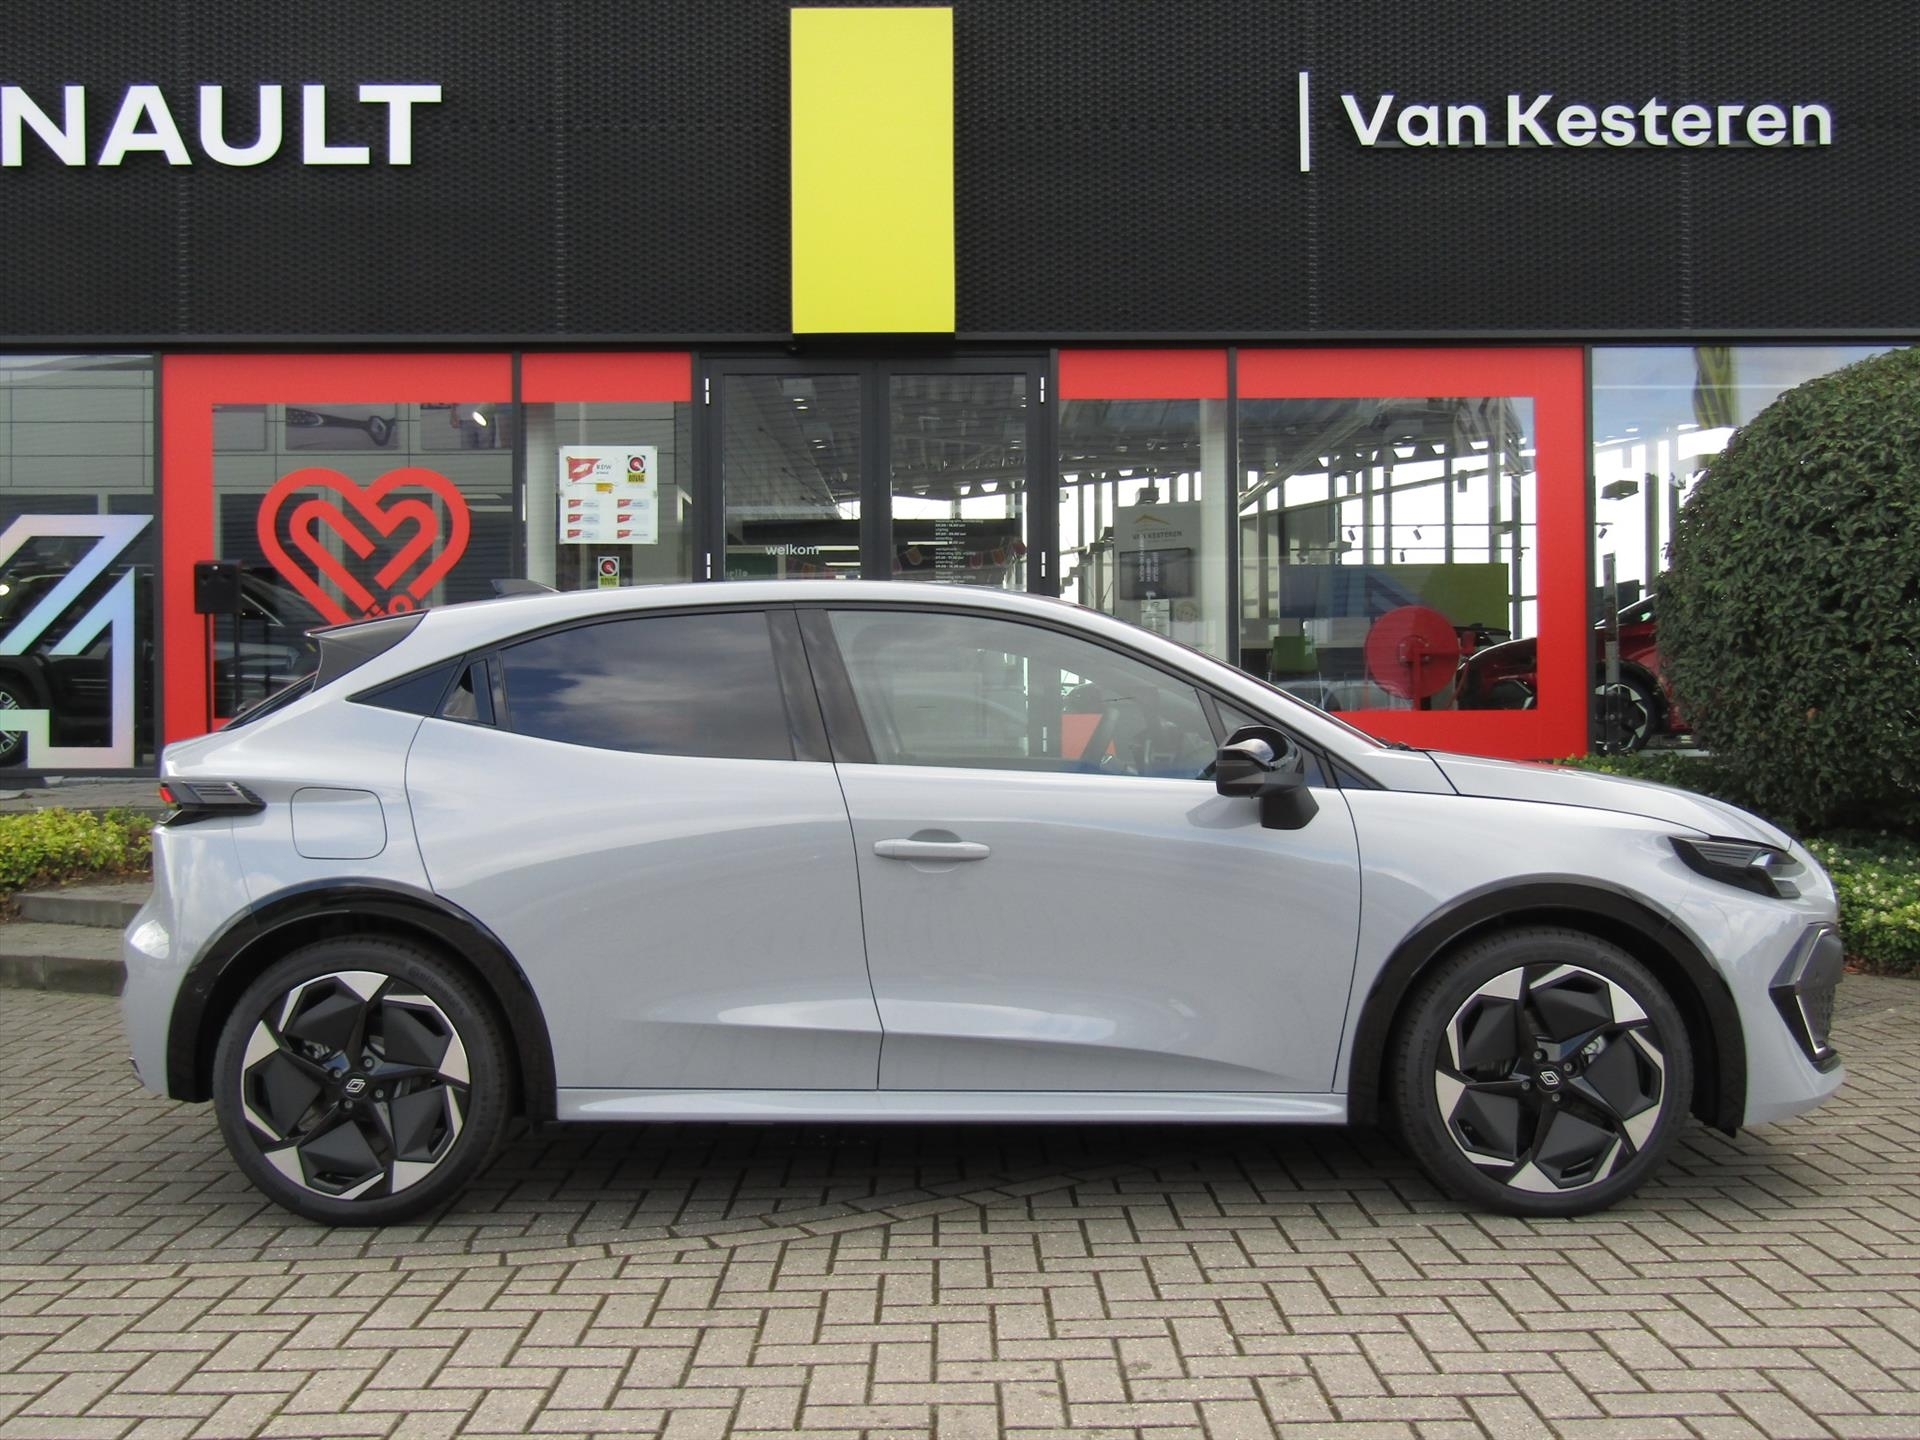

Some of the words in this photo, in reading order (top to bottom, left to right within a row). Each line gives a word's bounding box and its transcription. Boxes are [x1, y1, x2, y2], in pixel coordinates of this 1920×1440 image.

[1, 84, 442, 166] NAULT
[1341, 94, 1487, 146] Van
[1507, 94, 1833, 146] Kesteren
[765, 544, 820, 555] welkom
